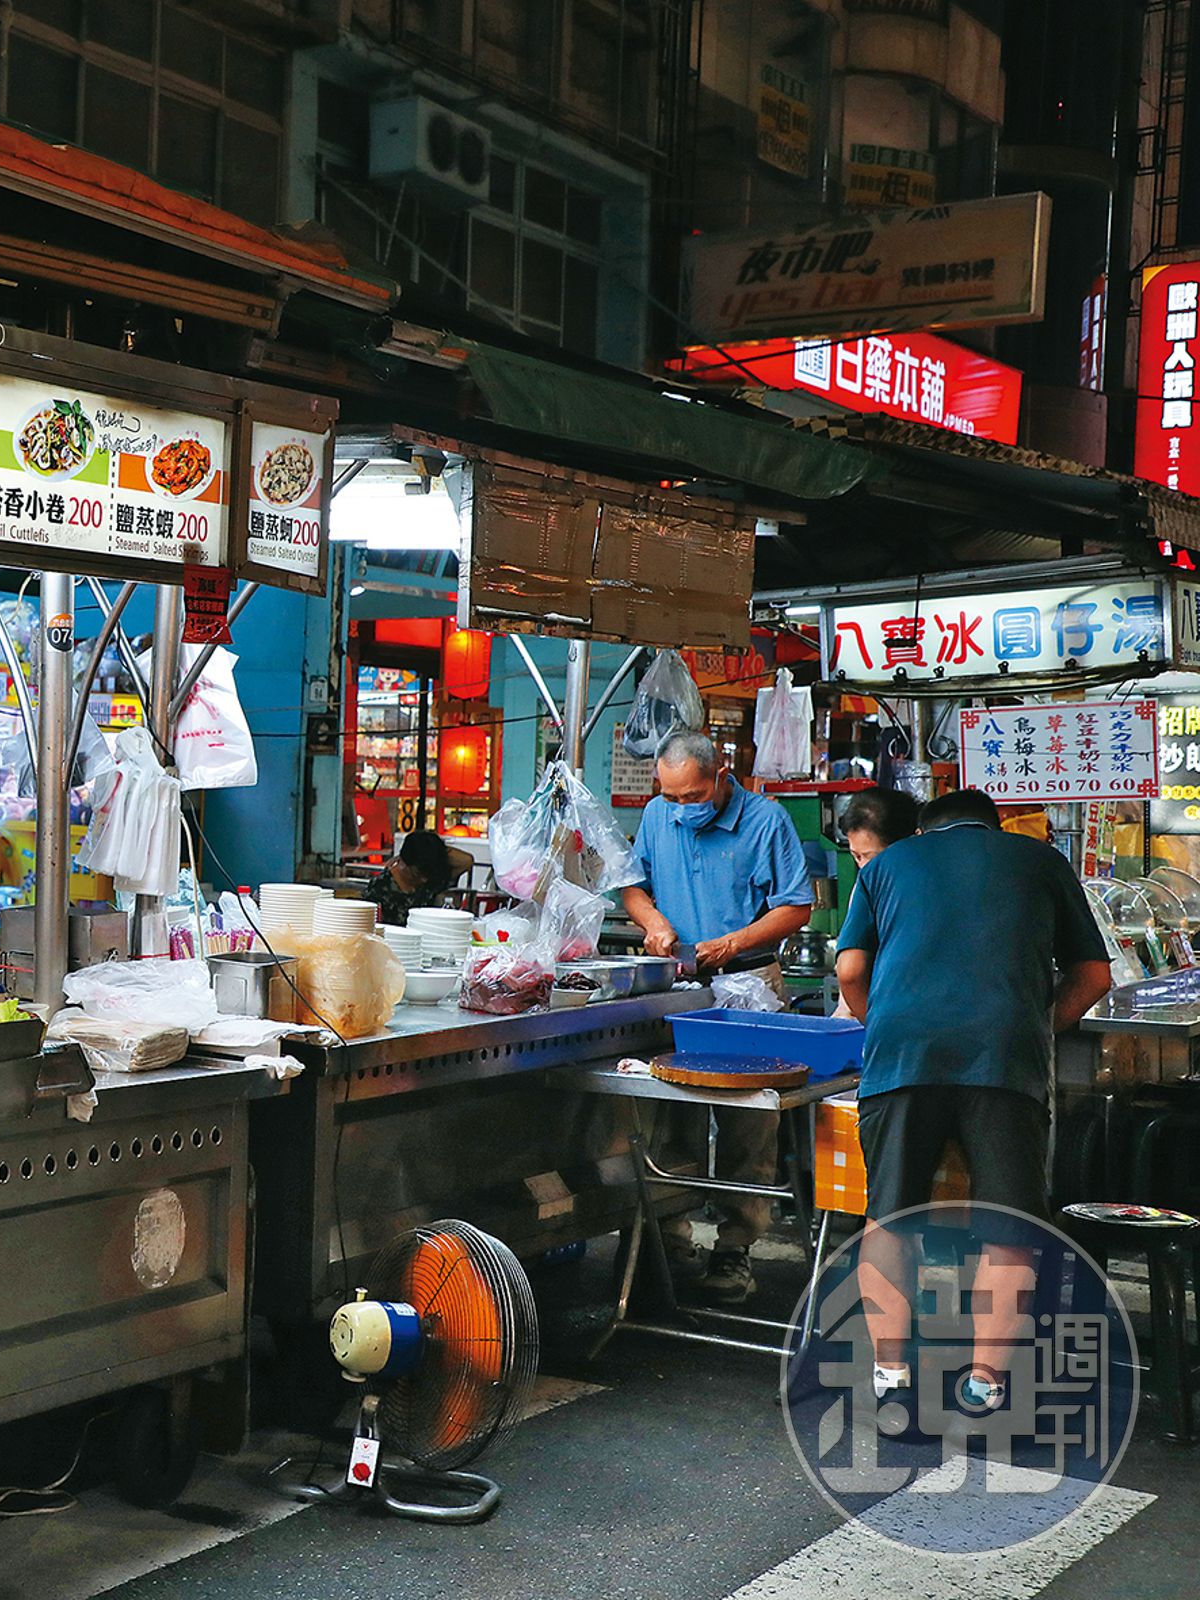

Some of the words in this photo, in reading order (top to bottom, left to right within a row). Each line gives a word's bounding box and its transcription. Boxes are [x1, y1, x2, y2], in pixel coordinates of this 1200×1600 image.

[736, 231, 878, 285] 夜市吧
[1161, 281, 1198, 429] 歐洲人玩具
[836, 336, 945, 424] 日藥本舖
[68, 496, 103, 529] 200
[115, 503, 174, 539] 鹽蒸蝦
[176, 512, 208, 543] 200
[249, 510, 293, 543] 鹽蒸蚵
[293, 518, 320, 547] 200
[10, 524, 50, 544] Cuttlefis
[115, 536, 150, 553] Steamed
[153, 541, 177, 558] Salted
[250, 542, 276, 557] Steamed
[278, 547, 296, 560] Salted
[298, 549, 317, 563] Oyster
[1181, 588, 1200, 642] 八
[1013, 717, 1037, 777] 烏梅冰
[1044, 714, 1068, 775] 草莓冰
[1075, 712, 1100, 774] 紅豆牛奶冰
[1109, 710, 1134, 773] 巧克力牛奶冰
[984, 781, 1009, 793] 60
[1015, 781, 1039, 793] 50
[1045, 780, 1070, 792] 50
[1075, 779, 1100, 791] 70
[1109, 778, 1135, 791] 60
